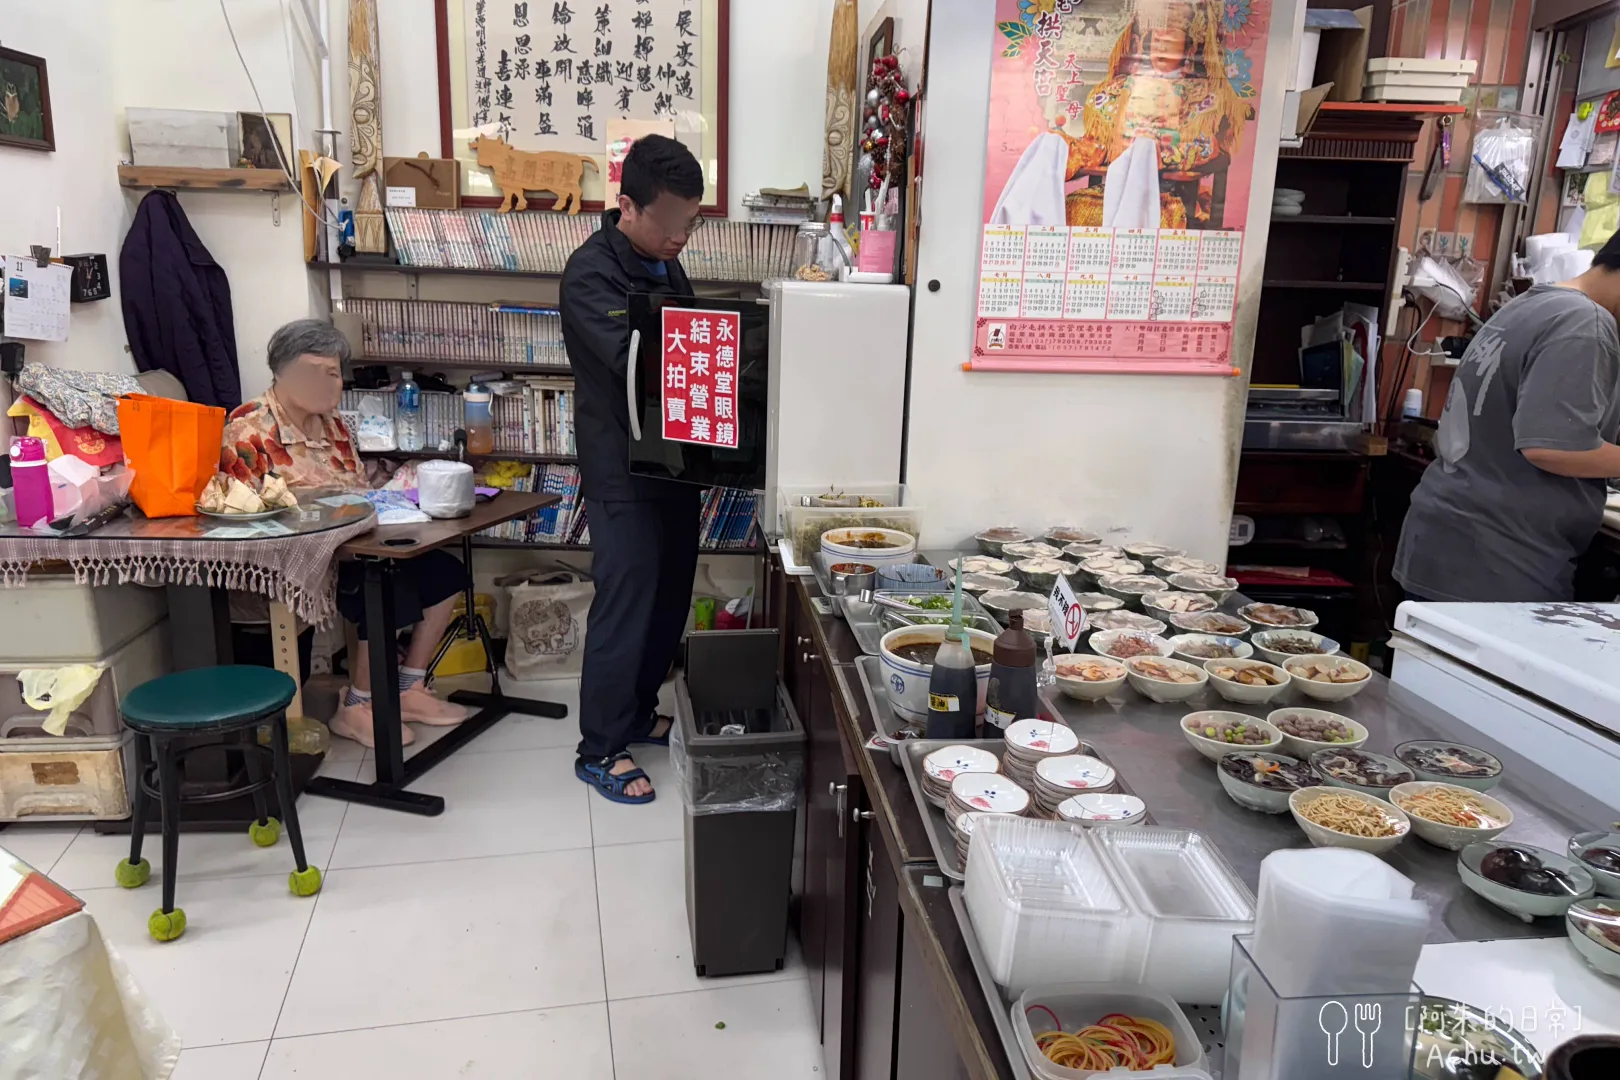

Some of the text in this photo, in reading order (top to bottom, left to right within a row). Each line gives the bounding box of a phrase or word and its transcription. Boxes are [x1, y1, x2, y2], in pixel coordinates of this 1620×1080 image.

[666, 328, 687, 424] 大拍賣
[689, 317, 711, 441] 結束營業
[714, 318, 735, 445] 永德堂眼鏡
